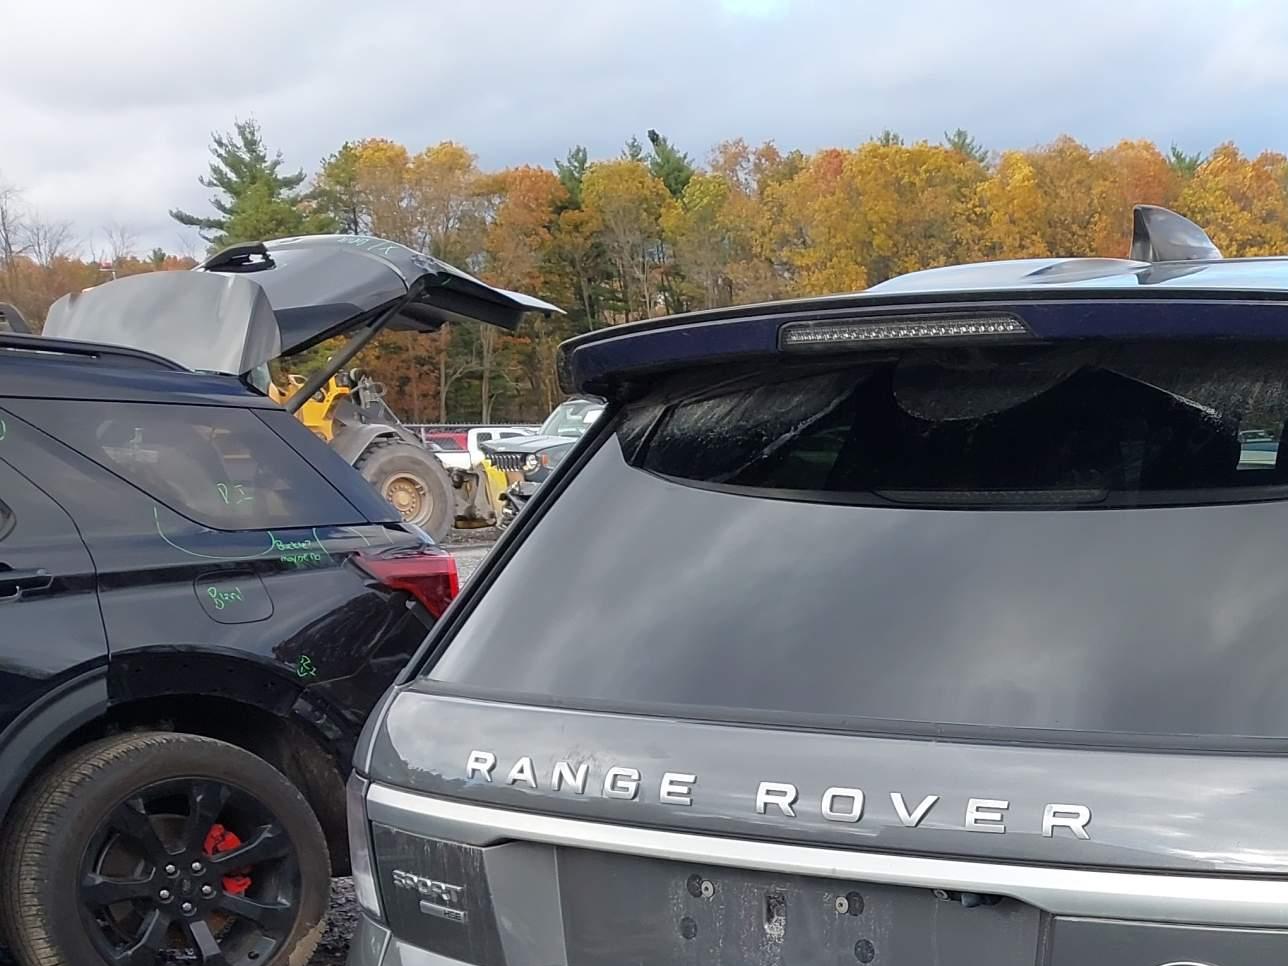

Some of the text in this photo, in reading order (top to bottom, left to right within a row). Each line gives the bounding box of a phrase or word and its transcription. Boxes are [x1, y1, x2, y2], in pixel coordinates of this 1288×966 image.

[466, 749, 1093, 840] RANGE ROVER
[392, 869, 464, 902] SPORT
